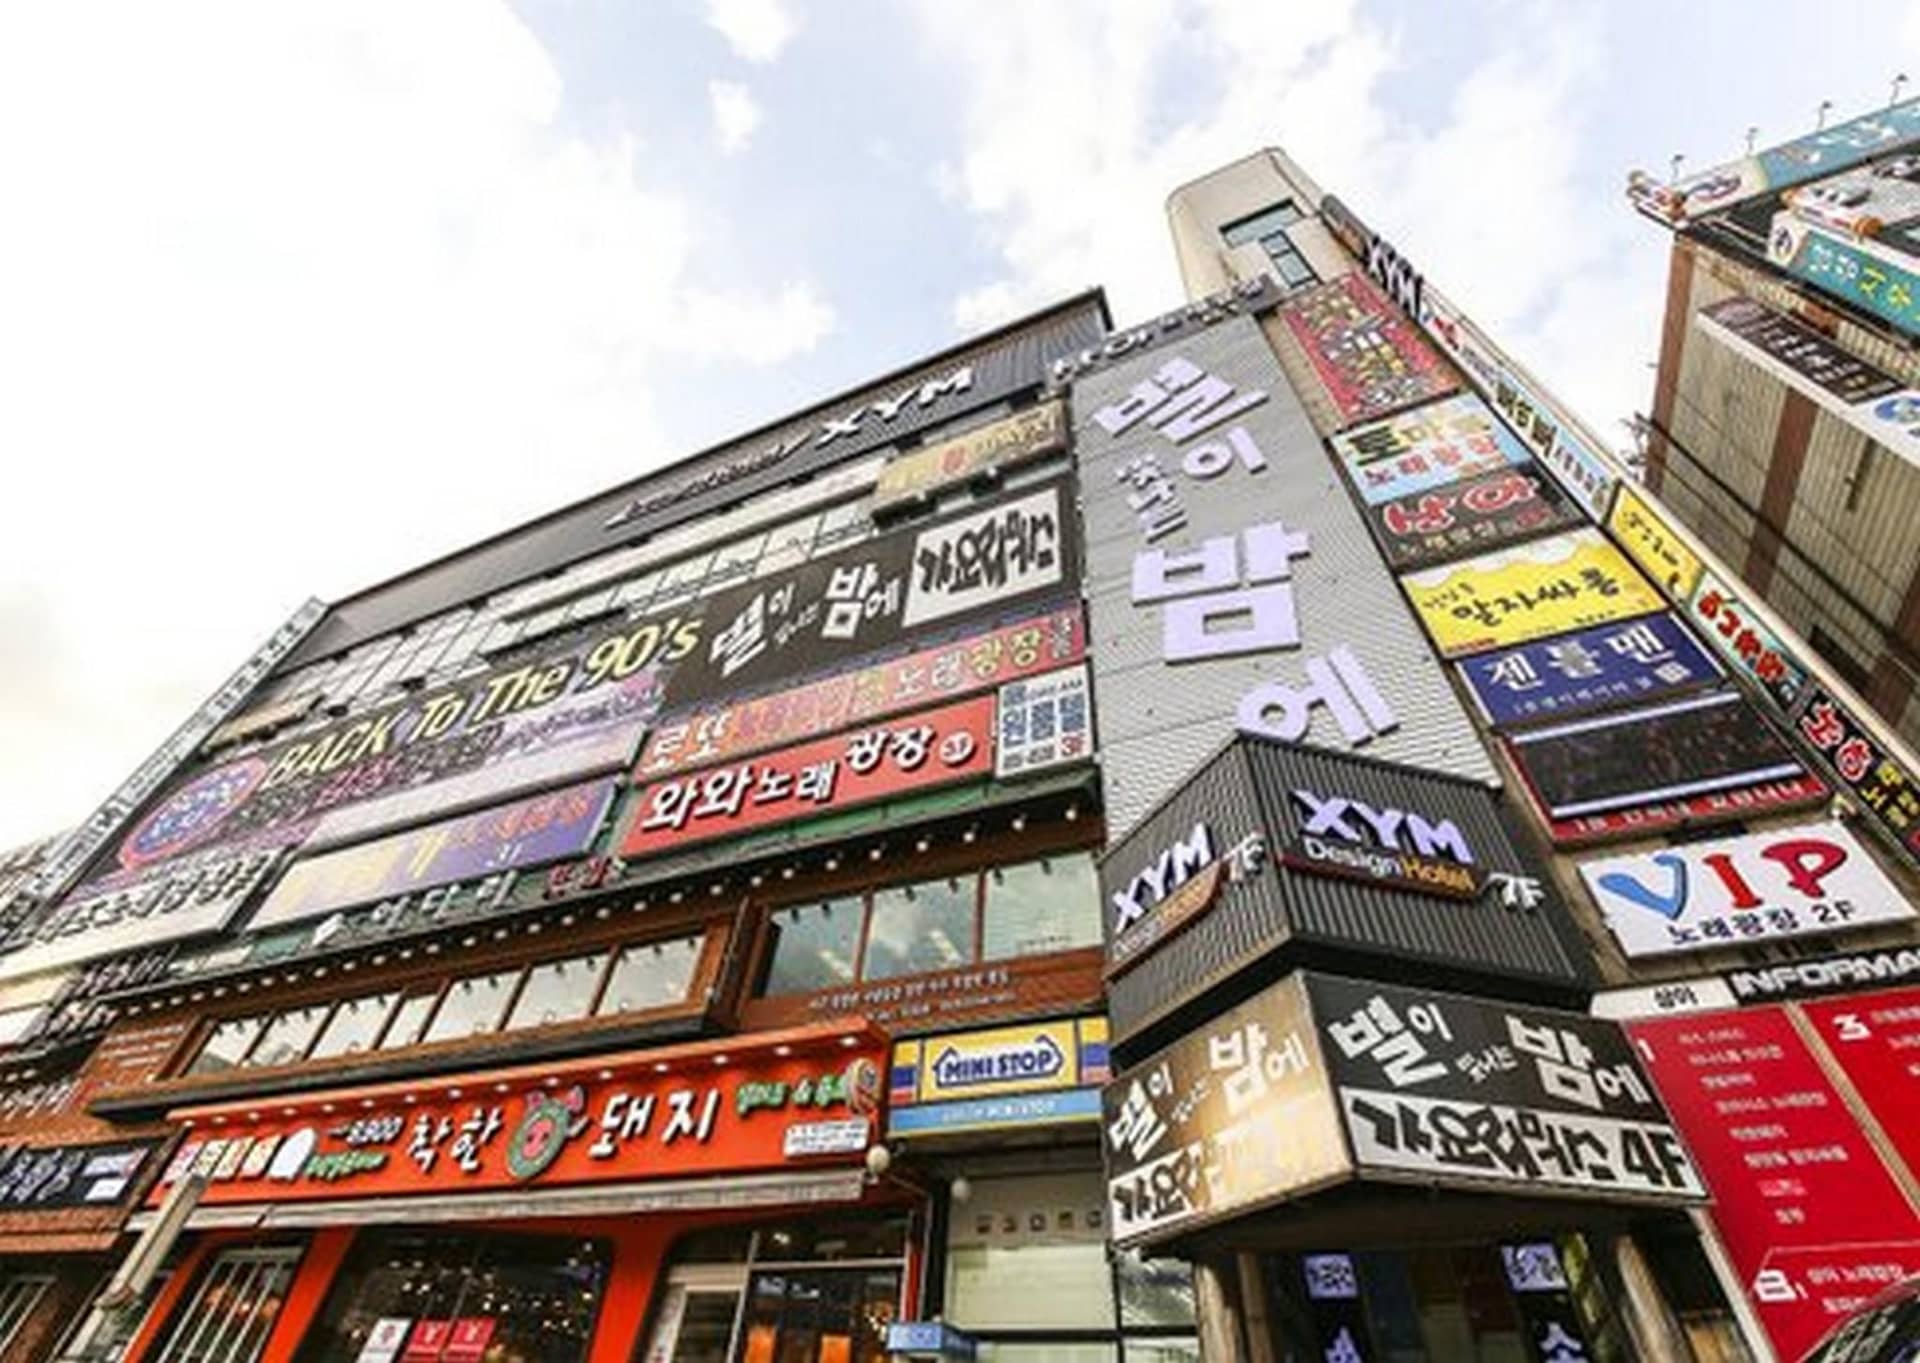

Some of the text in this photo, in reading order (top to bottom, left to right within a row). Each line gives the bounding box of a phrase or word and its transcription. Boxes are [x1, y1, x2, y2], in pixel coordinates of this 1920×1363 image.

[814, 367, 973, 450] XYM
[1290, 789, 1475, 865] XYM
[1112, 821, 1213, 934] XYM
[1598, 839, 1849, 921] VIP
[1667, 900, 1855, 945] 노래광장 2F
[944, 1049, 1052, 1080] MINI STOP
